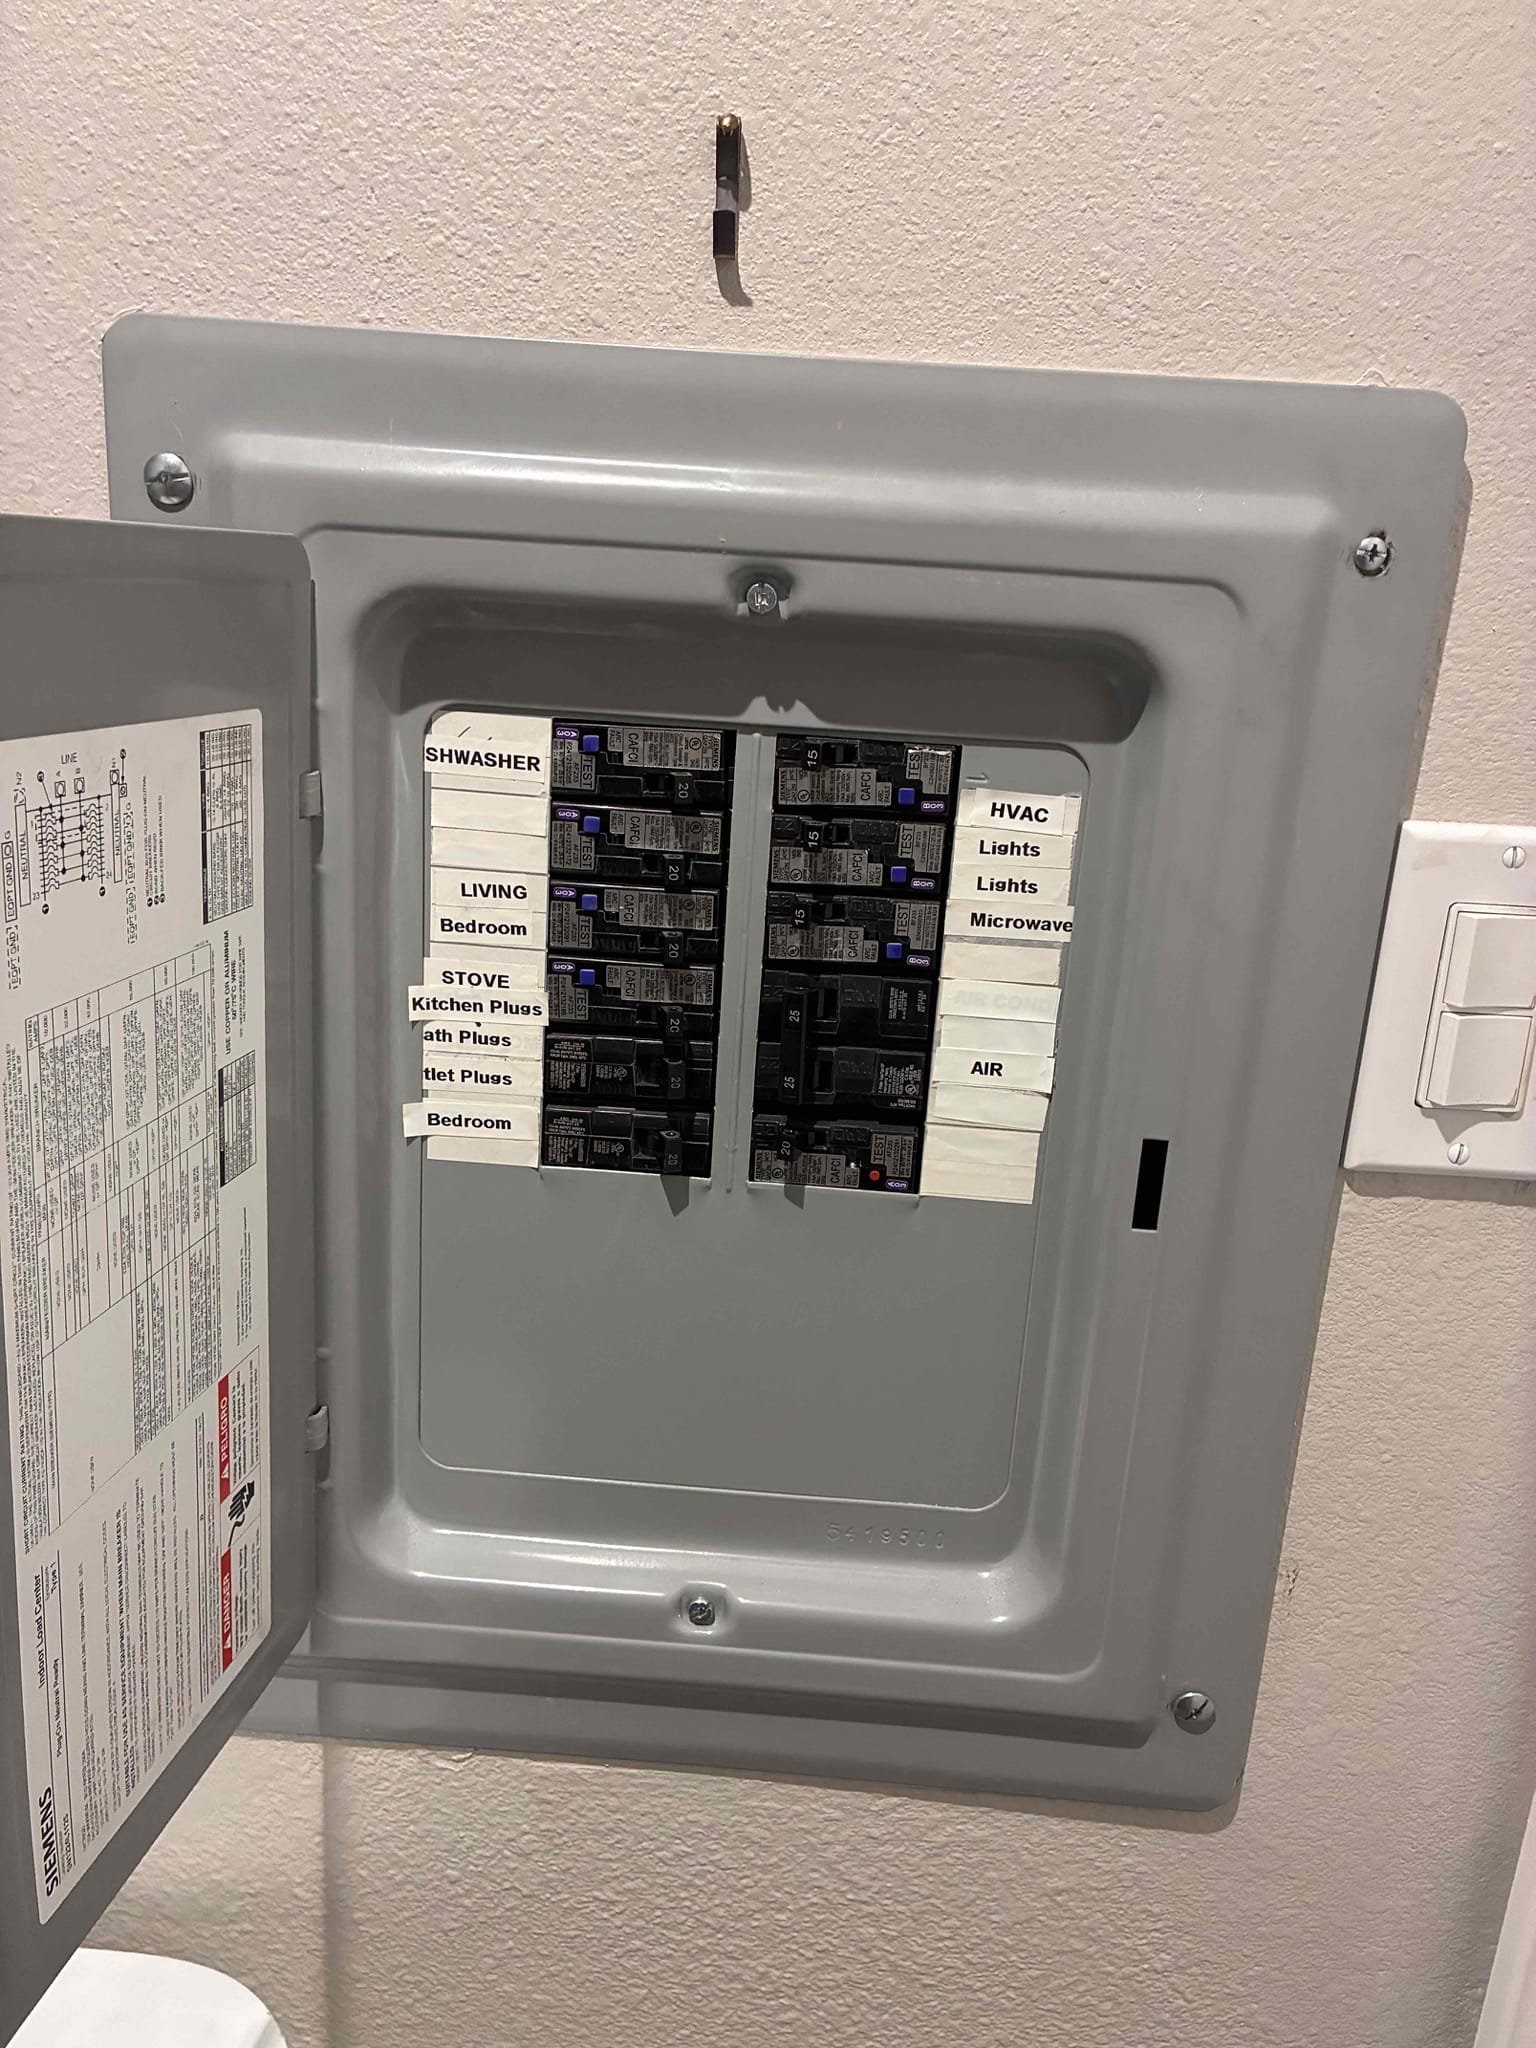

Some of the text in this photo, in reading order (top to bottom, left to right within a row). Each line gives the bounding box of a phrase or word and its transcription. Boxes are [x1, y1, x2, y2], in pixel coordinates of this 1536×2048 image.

[60, 752, 77, 764] LINE
[627, 733, 639, 763] CAFCI
[806, 749, 818, 767] 15
[425, 747, 541, 772] SHWASHER
[582, 756, 593, 788] TEST
[678, 783, 689, 799] 20
[860, 771, 872, 801] CAFCI
[990, 801, 1049, 823] HVAC
[629, 815, 641, 846] CAFCI
[808, 831, 819, 848] 15
[900, 825, 913, 857] TEST
[19, 830, 28, 880] NEUTRAL
[582, 838, 592, 868] TEST
[979, 839, 1041, 858] Lights
[668, 865, 680, 881] 20
[852, 852, 863, 882] CAFCI
[5, 861, 14, 916] EQPT GND
[461, 882, 528, 899] LIVING
[976, 876, 1039, 894] Lights
[624, 894, 635, 922] CAFCI
[794, 908, 806, 926] 15
[440, 918, 527, 936] Bedroom
[896, 905, 908, 934] TEST
[970, 911, 1073, 934] Microwave
[580, 918, 591, 947] TEST
[668, 943, 680, 959] 20
[847, 930, 859, 958] CAFCI
[224, 980, 229, 995] OR
[442, 971, 510, 989] STOVE
[625, 969, 636, 997] CAFCI
[412, 996, 543, 1016] Kitchen Plugs
[576, 990, 587, 1019] TEST
[788, 1009, 800, 1023] 25
[459, 1030, 512, 1047] Plugs
[460, 1069, 513, 1086] Plugs
[970, 1060, 1003, 1077] AIR
[671, 1076, 681, 1089] 20
[783, 1075, 795, 1089] 25
[427, 1112, 512, 1131] Bedroom
[781, 1140, 791, 1156] 20
[873, 1135, 884, 1163] TEST
[667, 1153, 679, 1166] 20
[830, 1158, 841, 1184] CAFCI
[220, 1393, 228, 1462] PELIGRO
[33, 1570, 46, 1689] Indoor Load Center
[38, 1783, 58, 1899] SIEMENS
